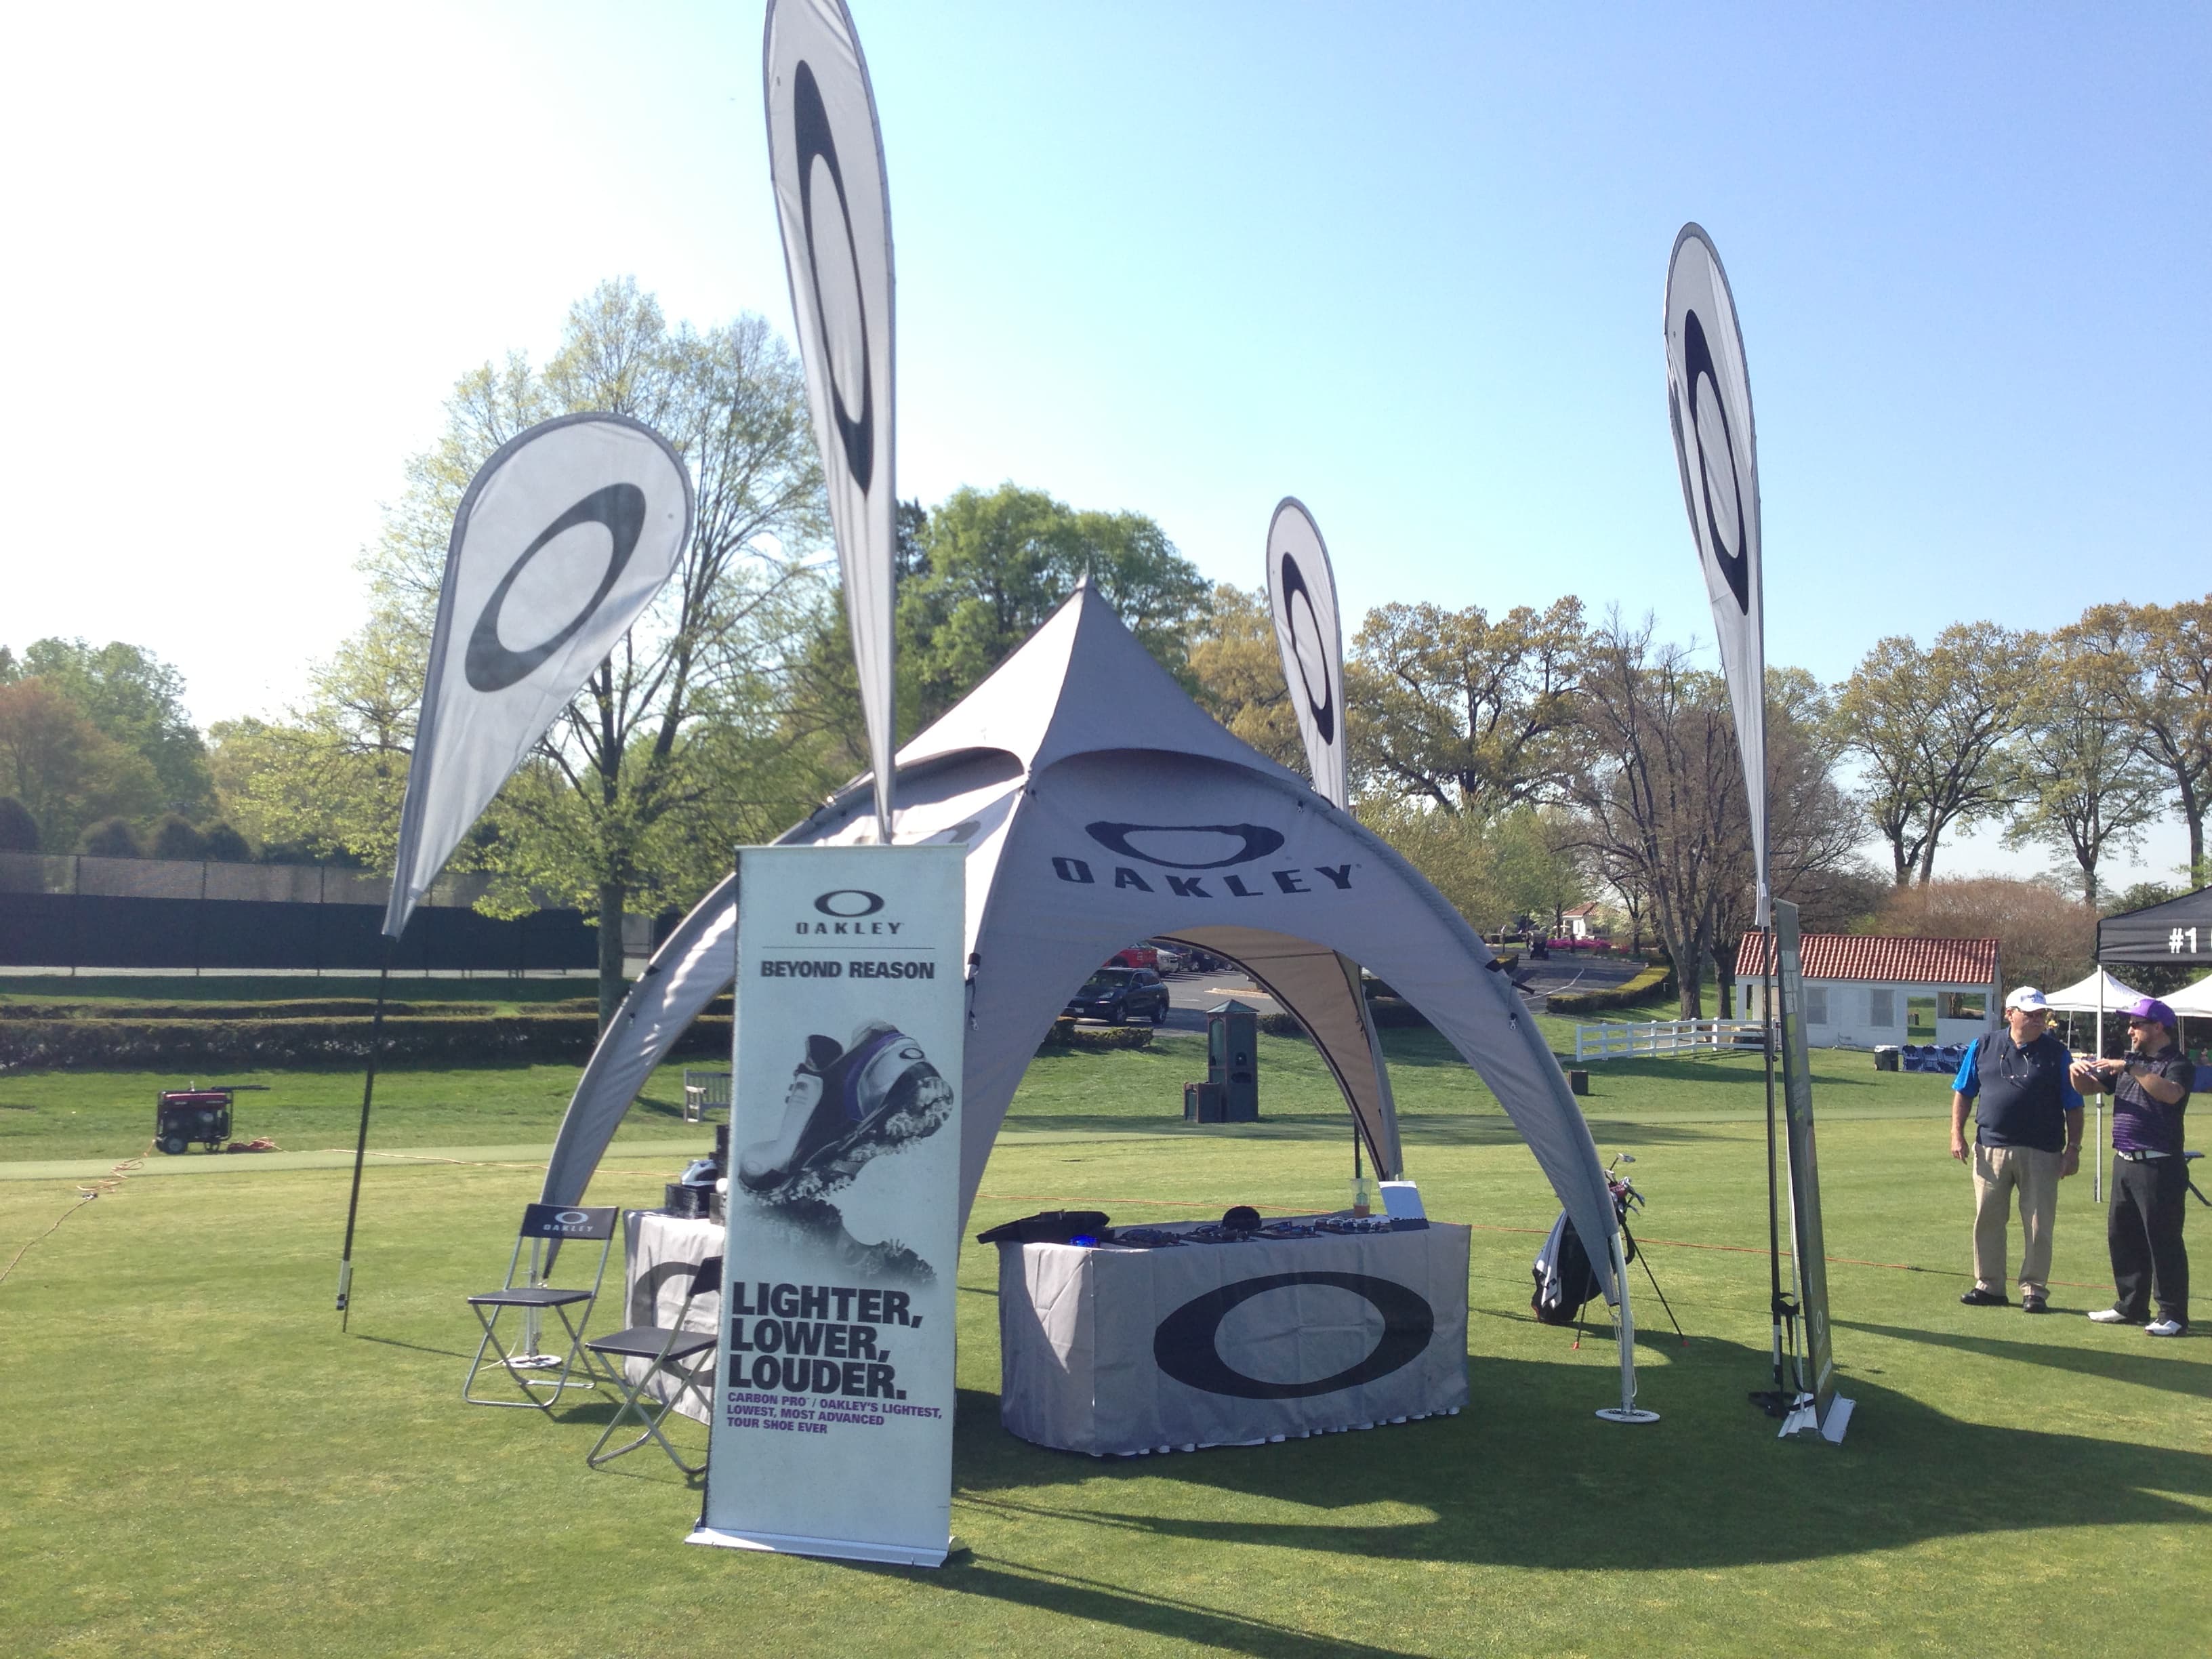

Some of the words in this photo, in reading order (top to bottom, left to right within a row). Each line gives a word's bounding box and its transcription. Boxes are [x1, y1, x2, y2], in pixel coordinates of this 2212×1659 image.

[1052, 857, 1353, 897] OAKLEY
[796, 922, 901, 935] OAKLEY
[2169, 927, 2196, 954] #1
[760, 960, 841, 977] BEYOND
[849, 961, 935, 979] REASON
[543, 1224, 594, 1232] OAKLEY
[732, 1282, 923, 1329] LIGHTER,
[731, 1318, 891, 1363] LOWER,
[728, 1354, 907, 1400] LOUDER.
[726, 1405, 777, 1418] LOWEST,
[780, 1408, 815, 1420] MOST
[818, 1412, 884, 1425] ADVANCED
[727, 1392, 778, 1405] CARBON
[819, 1399, 878, 1412] OAKLEY'S
[882, 1404, 942, 1419] LIGHTEST,
[727, 1417, 760, 1429] TOUR
[763, 1419, 795, 1431] SHOE
[798, 1422, 827, 1434] EVER
